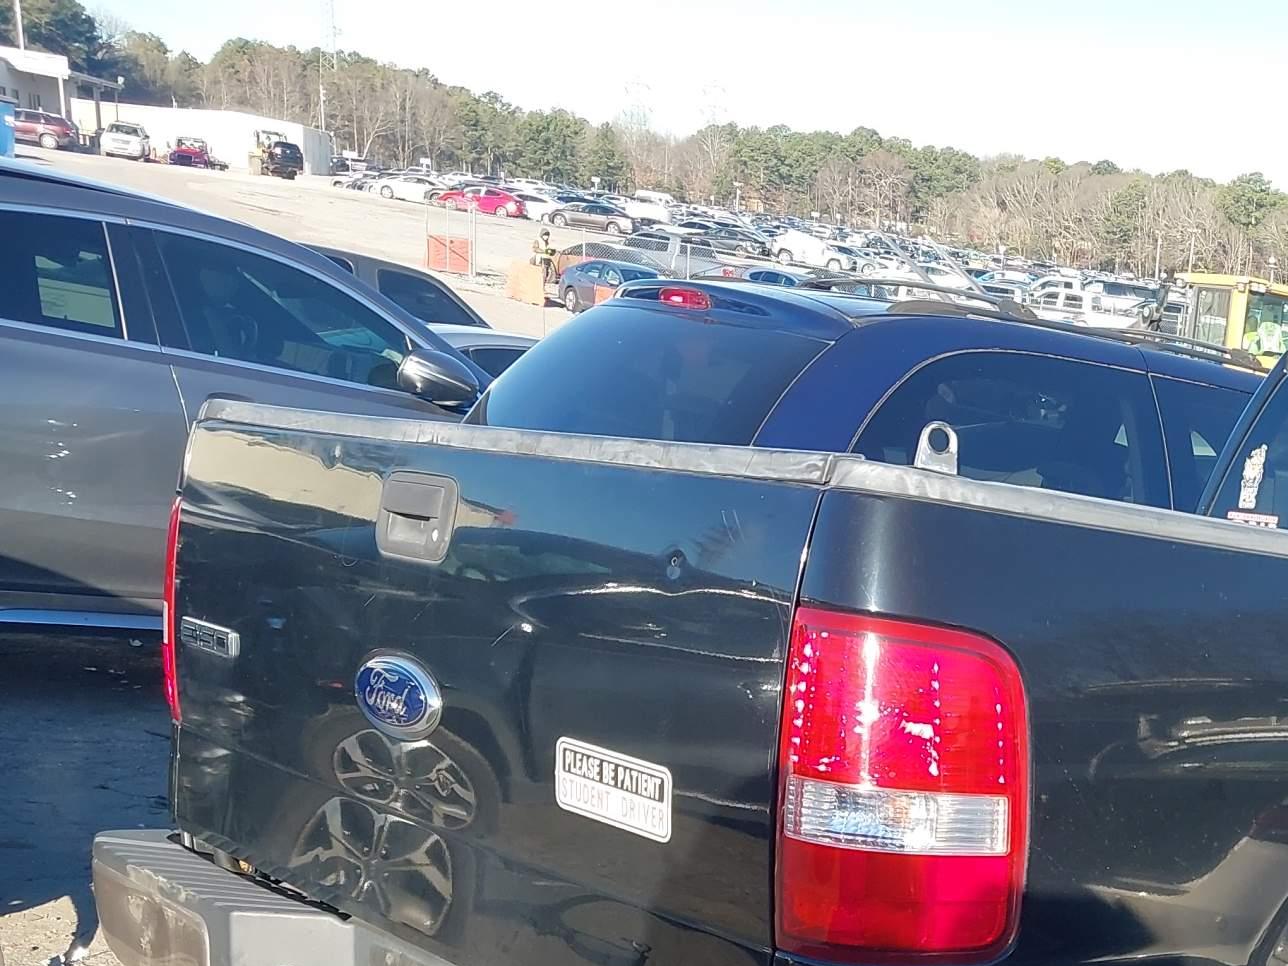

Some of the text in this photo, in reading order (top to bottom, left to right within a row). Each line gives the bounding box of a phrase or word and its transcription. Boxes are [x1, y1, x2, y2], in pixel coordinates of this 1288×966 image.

[365, 668, 414, 715] Ford
[565, 749, 662, 801] PLEASE BE PATIENT
[561, 777, 664, 832] STUDENT DRIVER
